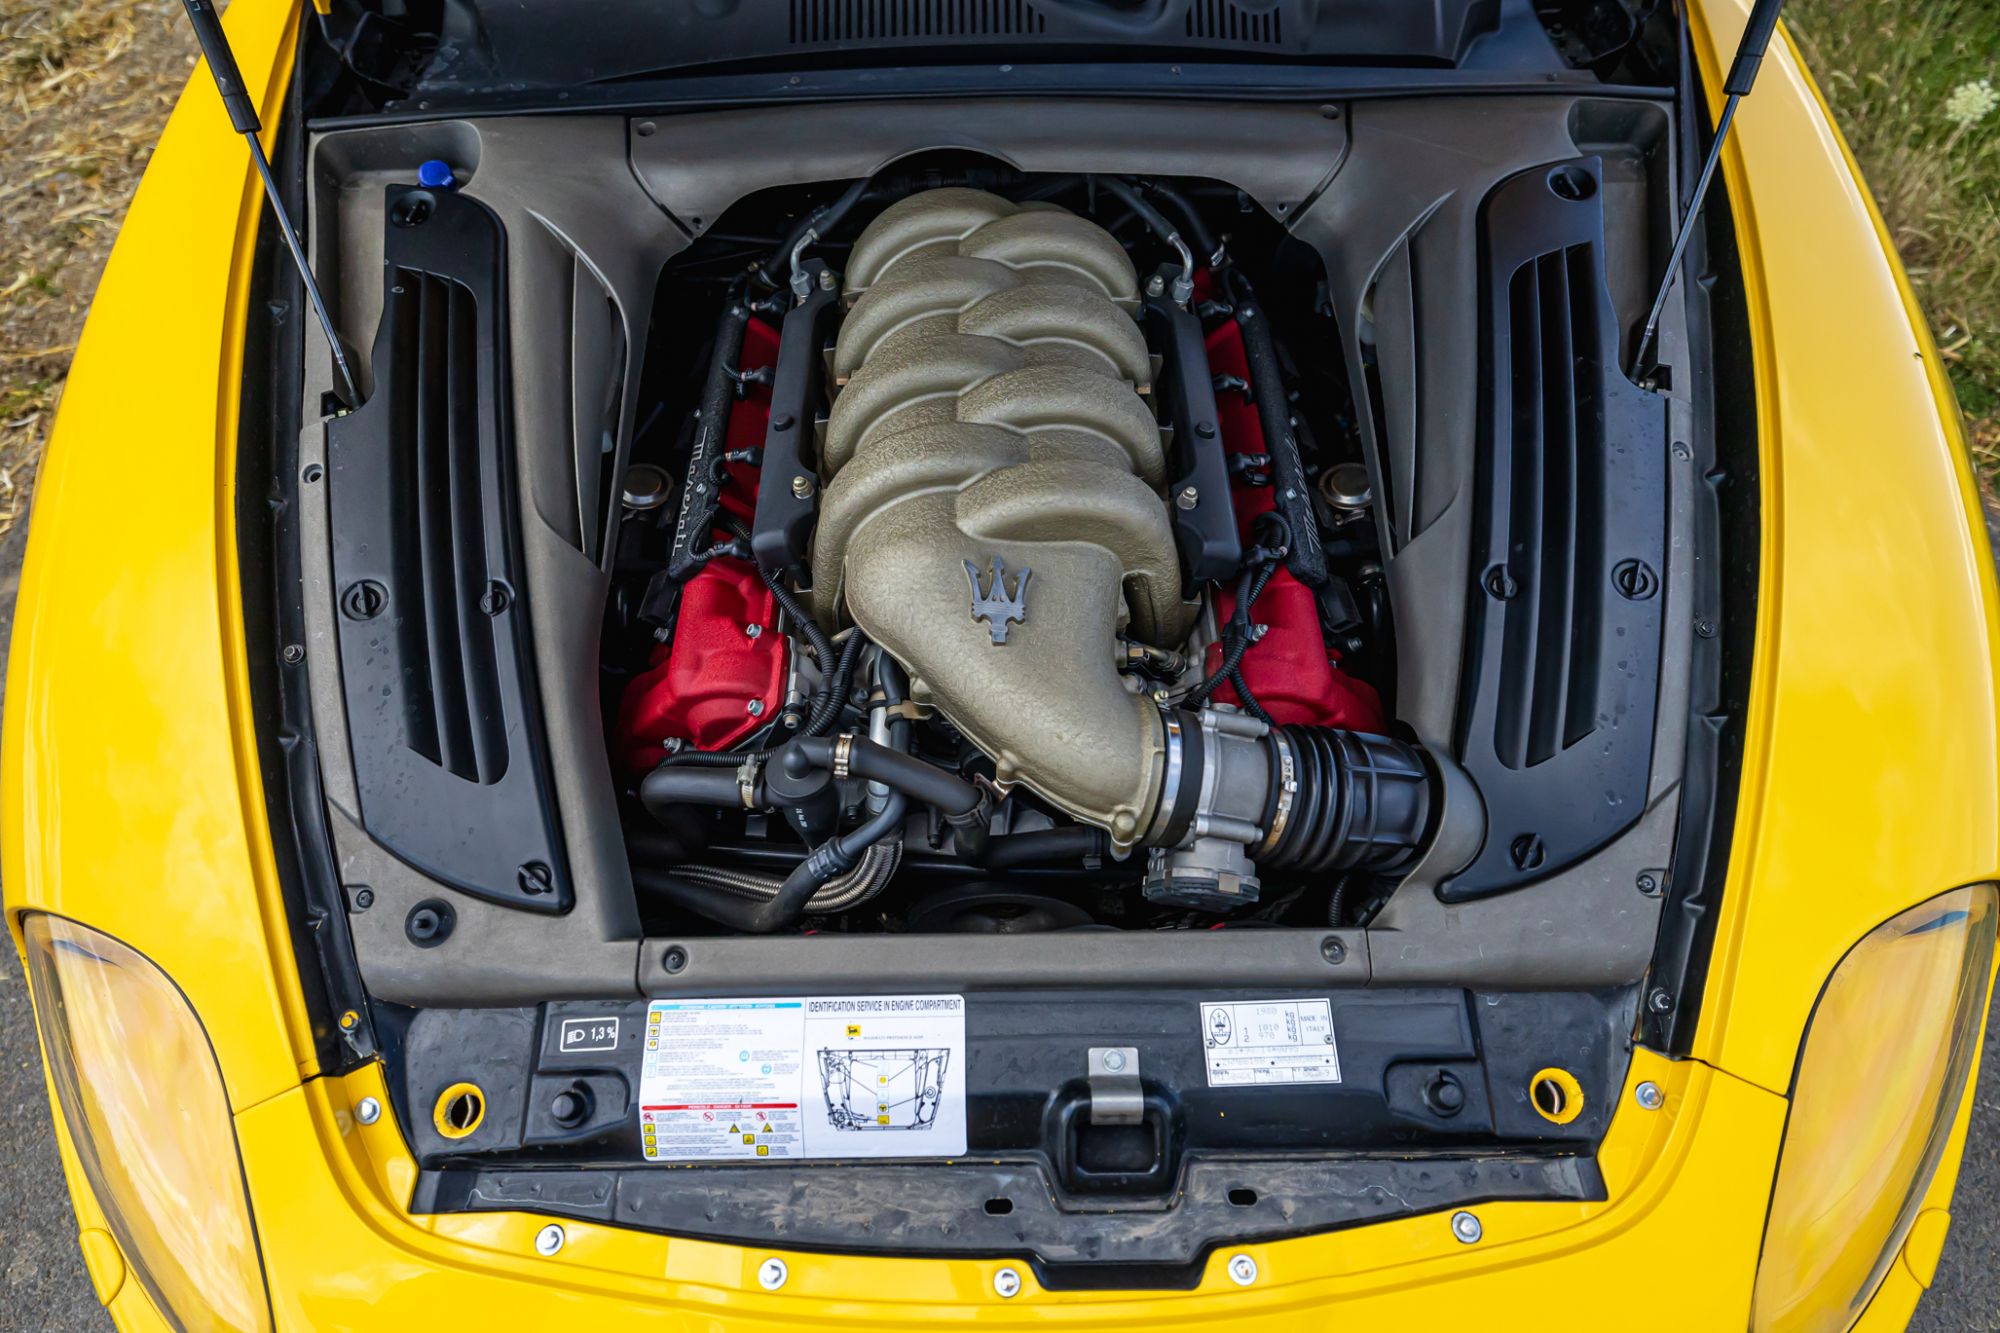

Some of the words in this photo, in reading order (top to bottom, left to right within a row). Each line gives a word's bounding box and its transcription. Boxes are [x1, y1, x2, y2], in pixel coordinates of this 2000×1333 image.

[808, 1000, 855, 1013] IDENTIFICATION
[857, 1000, 882, 1012] SERVICE
[884, 1000, 890, 1011] IN
[891, 999, 914, 1011] ENGINE
[915, 998, 961, 1011] COMPARTMENT
